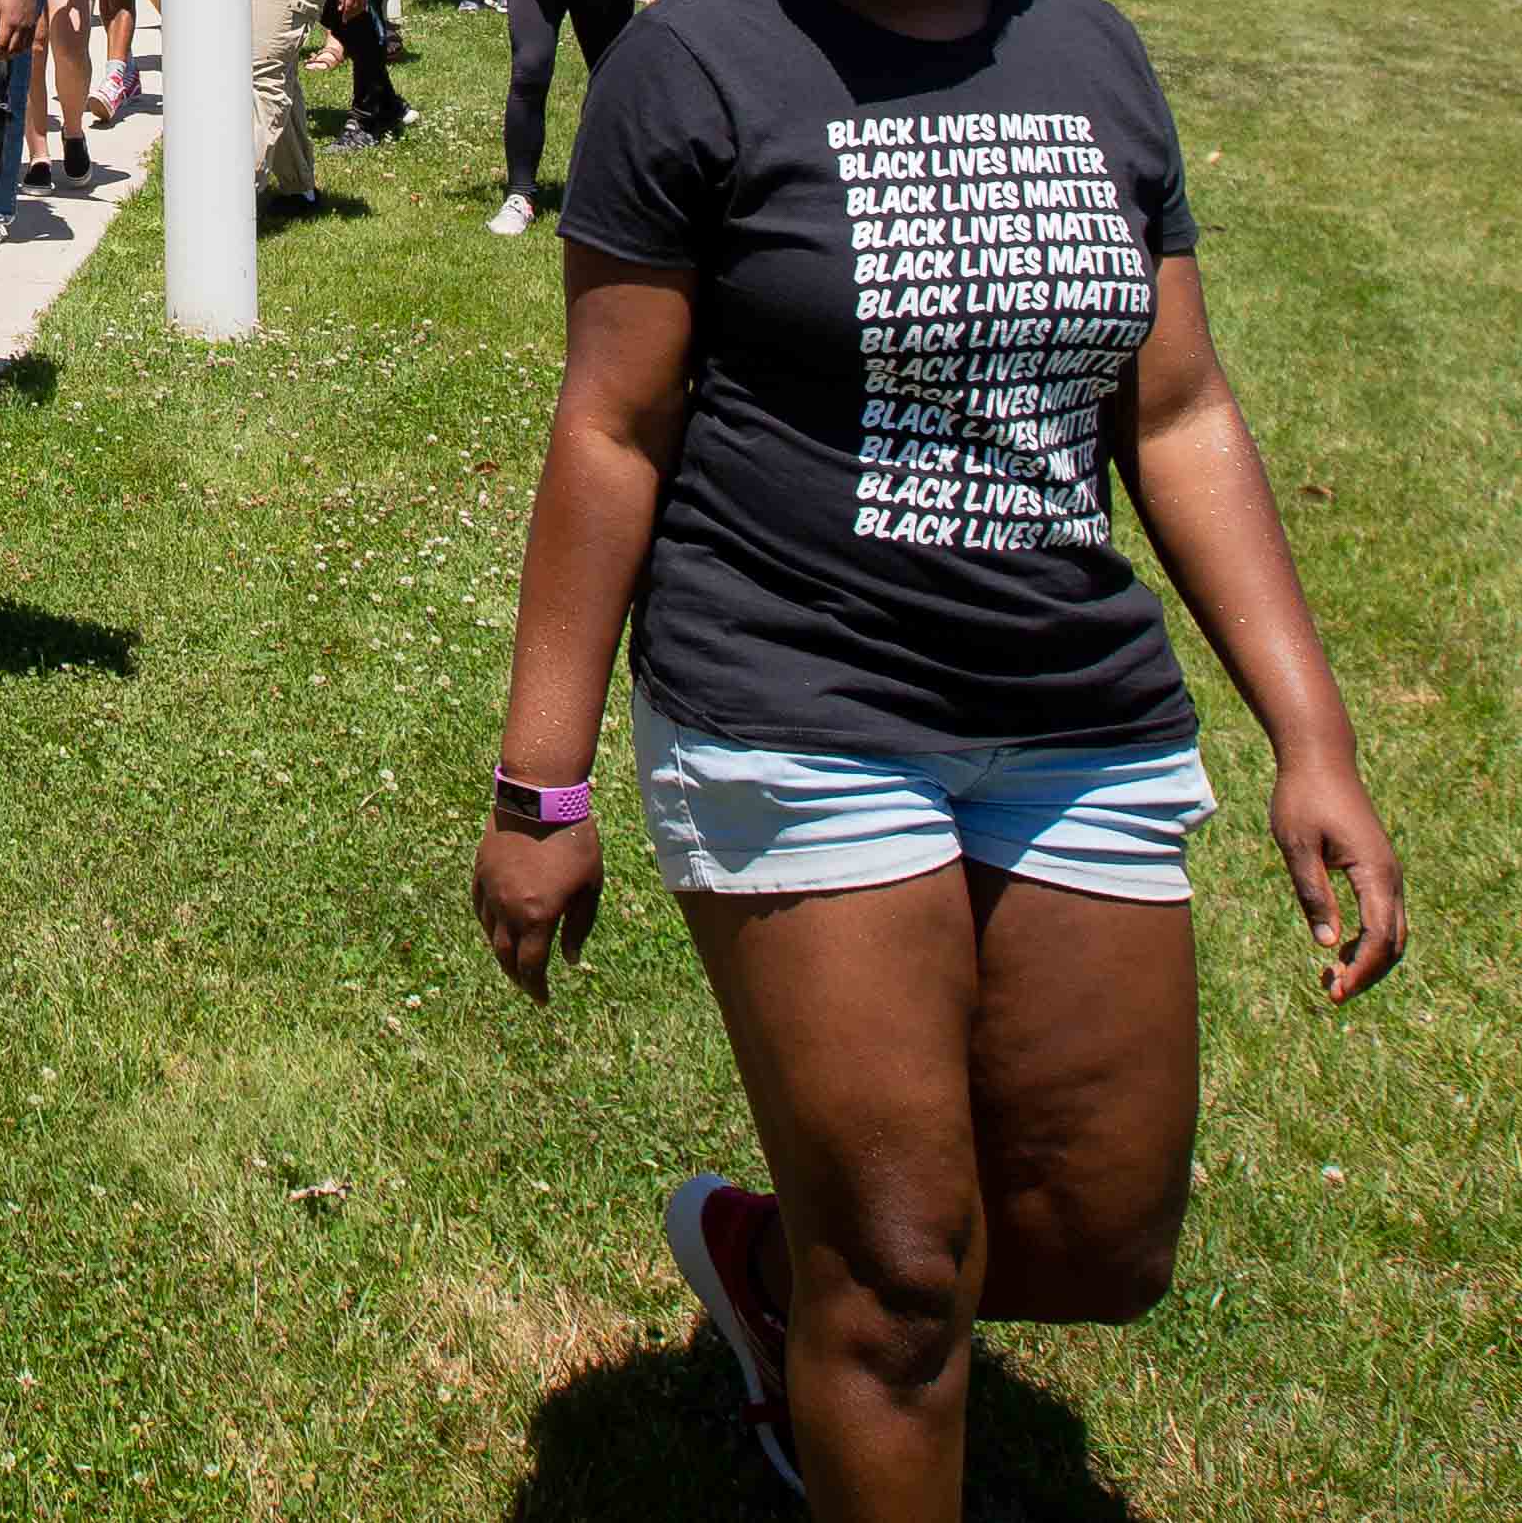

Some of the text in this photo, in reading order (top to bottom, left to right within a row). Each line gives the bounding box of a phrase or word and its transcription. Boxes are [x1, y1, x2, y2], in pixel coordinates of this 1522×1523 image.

[827, 114, 1095, 149] BLACK LIVES MATTER
[837, 147, 1107, 181] BLACK LIVES MATTER
[847, 181, 1118, 216] BLACK LIVES MATTER
[852, 213, 1133, 249] BLACK LIVES MATTER
[855, 247, 1146, 284] BLACK LIVES MATTER
[856, 281, 1150, 319] BLACK LIVES MATTER
[860, 322, 963, 354] BLACK
[968, 318, 1051, 348] LIVES
[865, 355, 963, 381] BLACK
[966, 352, 1045, 382] LIVES
[865, 374, 965, 408] BLACK
[966, 386, 1039, 418] LIVES
[862, 401, 961, 436] BLACK
[962, 422, 1038, 451] LIVES
[859, 438, 959, 472] BLACK
[964, 451, 1044, 479] LIVES
[856, 473, 962, 511] BLACK
[964, 484, 1043, 517] LIVES
[855, 509, 961, 547] BLACK
[964, 518, 1043, 551] LIVES
